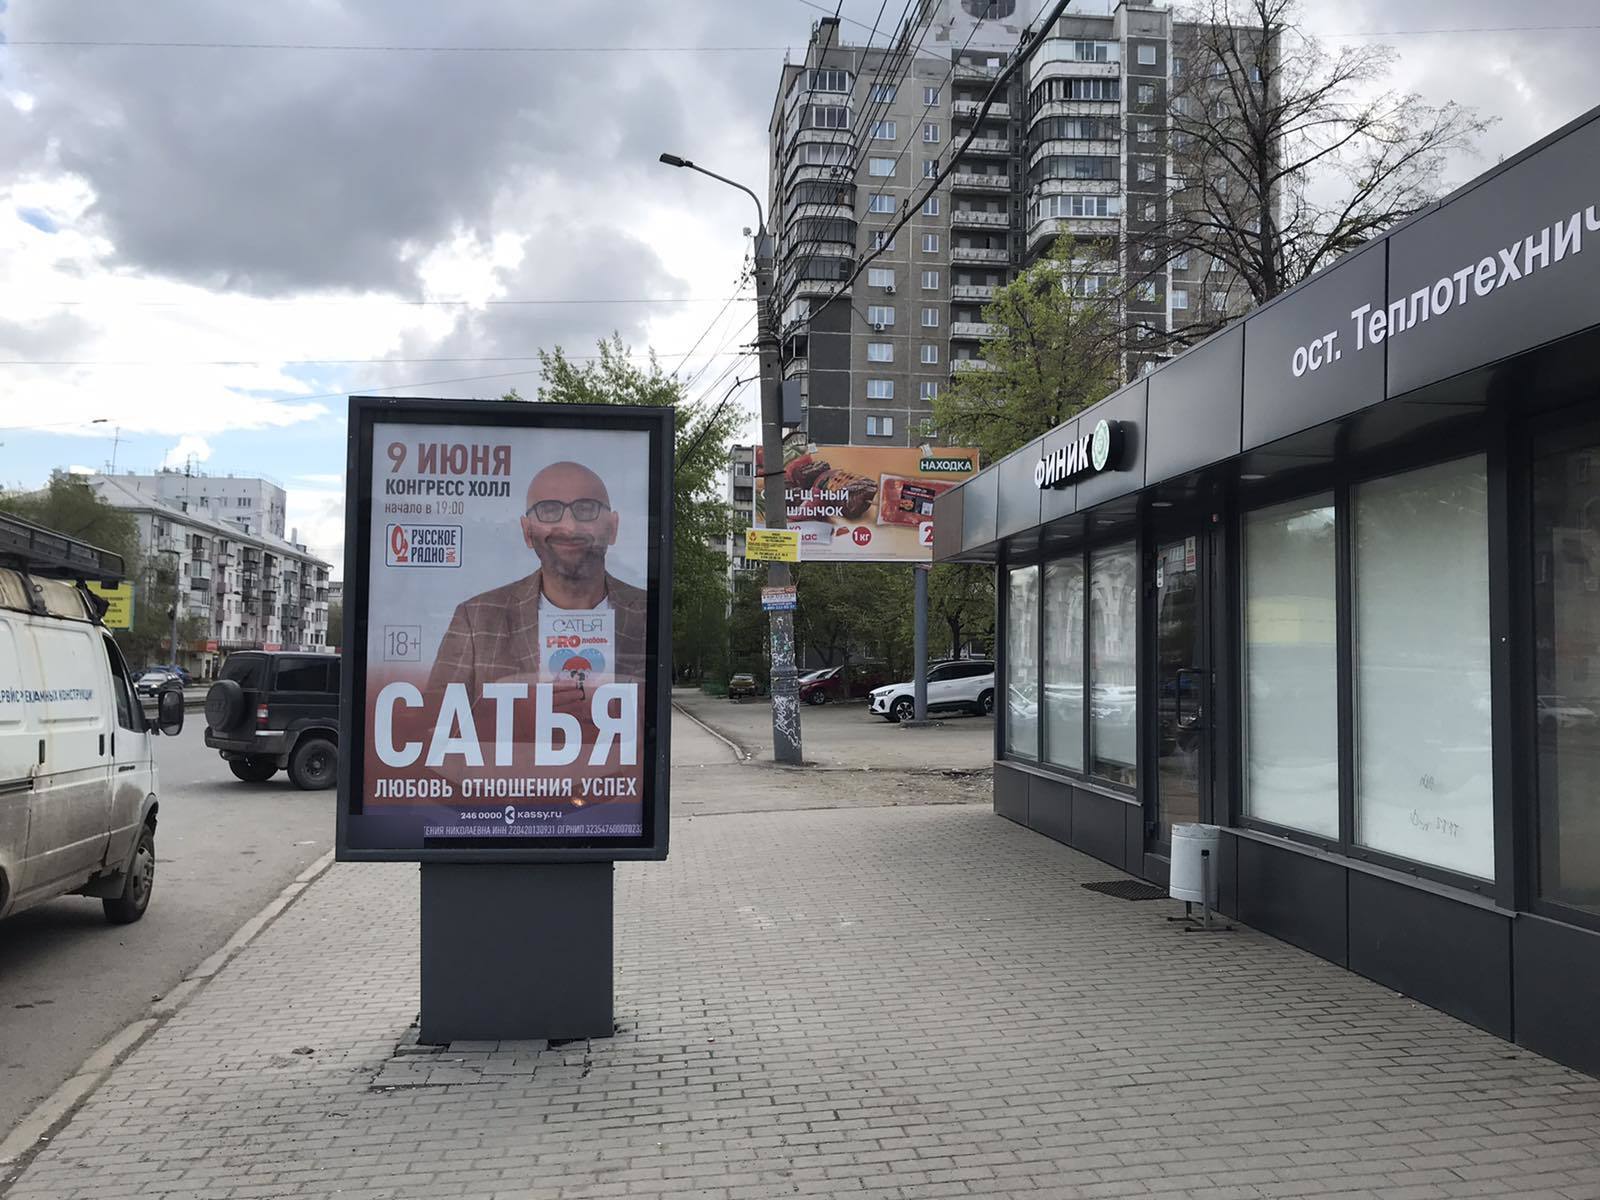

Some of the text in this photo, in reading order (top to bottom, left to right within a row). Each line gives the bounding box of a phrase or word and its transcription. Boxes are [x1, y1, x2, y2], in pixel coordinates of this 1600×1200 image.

[1292, 330, 1342, 377] ост.
[387, 441, 512, 476] 9 ИЮНЯ
[921, 461, 972, 471] НАХОДКА
[1034, 433, 1090, 489] ФИНИК
[385, 478, 511, 497] КОНГРЕСС ХОЛЛ
[385, 501, 464, 515] начало в 19:00
[786, 506, 843, 517] ШЛЫЧОК
[411, 529, 456, 546] РУССКОЕ
[552, 618, 603, 633] САТЬЯ
[388, 631, 420, 656] 18+
[374, 681, 639, 768] САТЬЯ
[374, 777, 637, 798] ЛЮБОВЬ ОТНОШЕНИЯ УСПЕХ
[518, 811, 562, 821] kassy.ru
